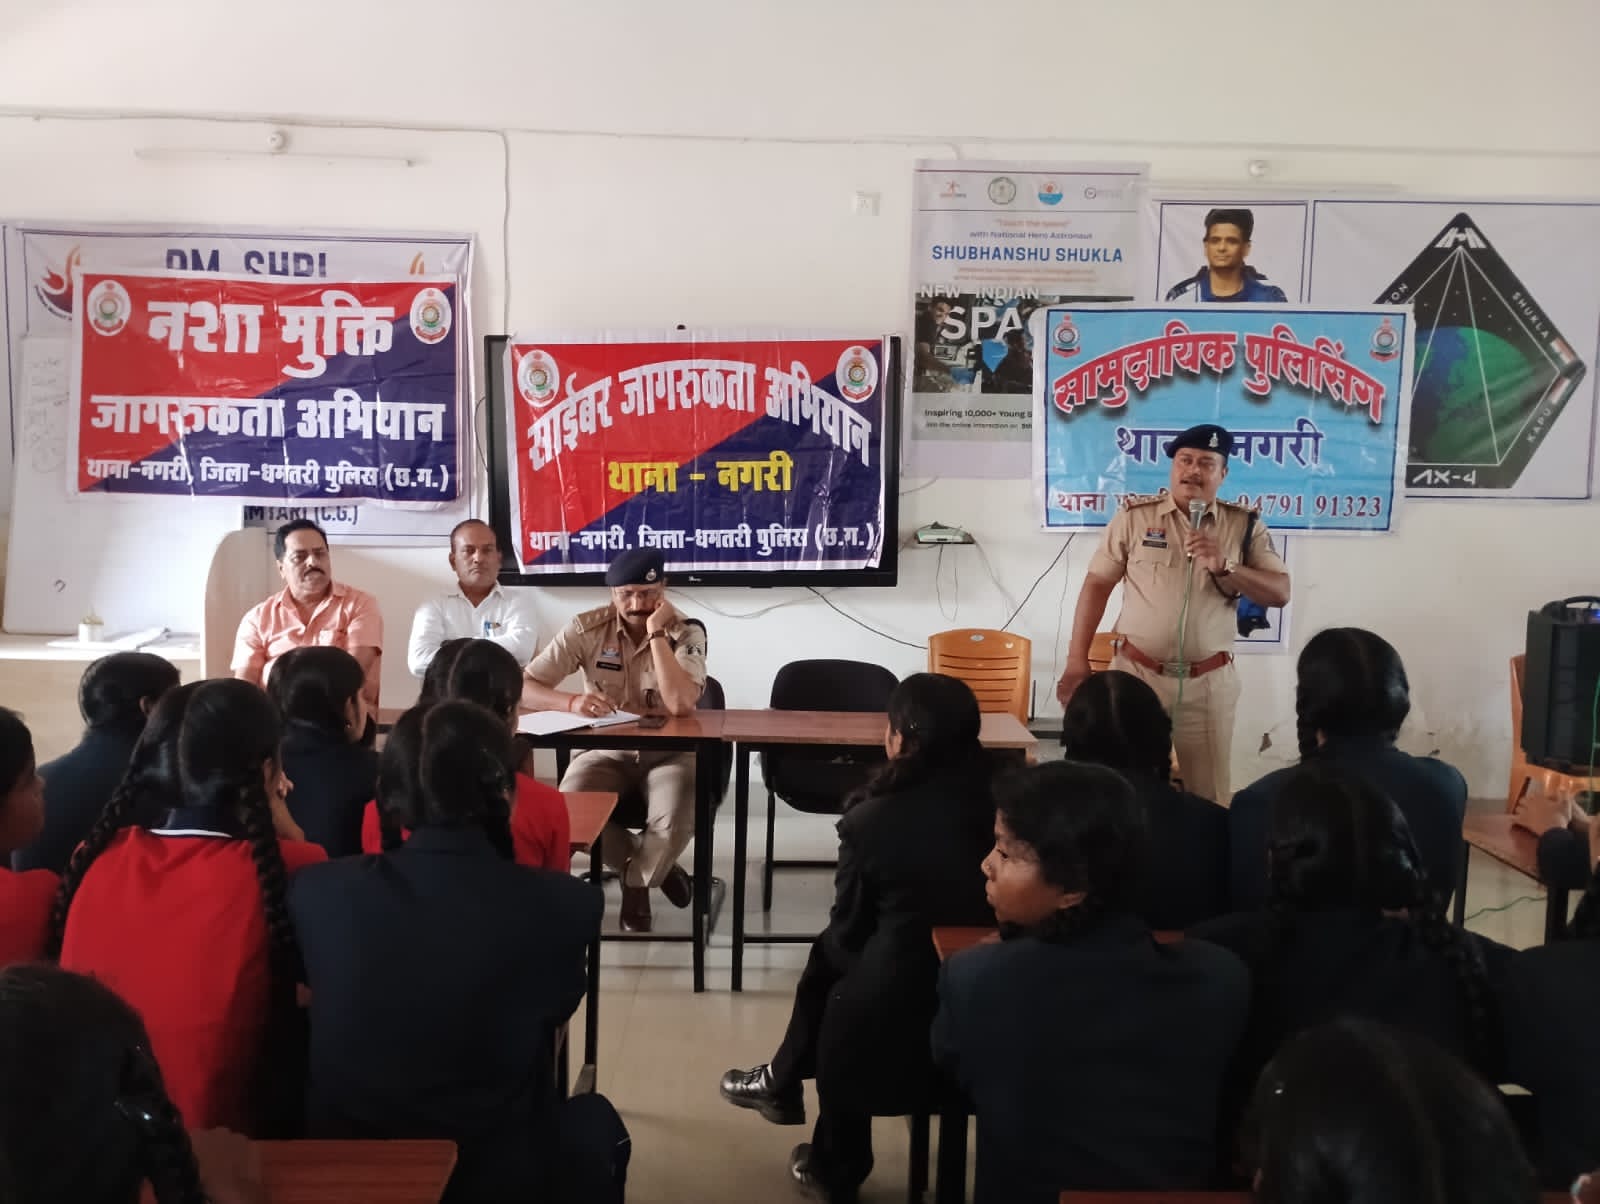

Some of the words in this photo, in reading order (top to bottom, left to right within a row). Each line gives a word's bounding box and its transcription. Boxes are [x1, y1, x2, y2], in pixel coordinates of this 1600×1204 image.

[932, 245, 1051, 261] SHUBHANSHU
[1055, 247, 1124, 262] SHUKLA
[990, 231, 1026, 239] National
[148, 300, 263, 353] नशा
[281, 290, 396, 378] मुक्ति
[940, 306, 1034, 344] SPA
[1512, 291, 1549, 339] SHUKLA
[1053, 320, 1238, 414] सामुदायिक
[1244, 321, 1386, 424] पुलिसिंग
[297, 389, 446, 440] अभियान
[527, 372, 613, 472] साईबर
[765, 360, 872, 468] अभियान
[924, 408, 963, 418] Inspiring
[965, 409, 997, 417] 10,000+
[999, 410, 1026, 419] Young
[325, 460, 379, 493] पुलिस
[608, 461, 679, 493] थाना
[716, 450, 794, 493] नगरी
[1315, 495, 1382, 517] 91323
[756, 523, 808, 556] पुलिस
